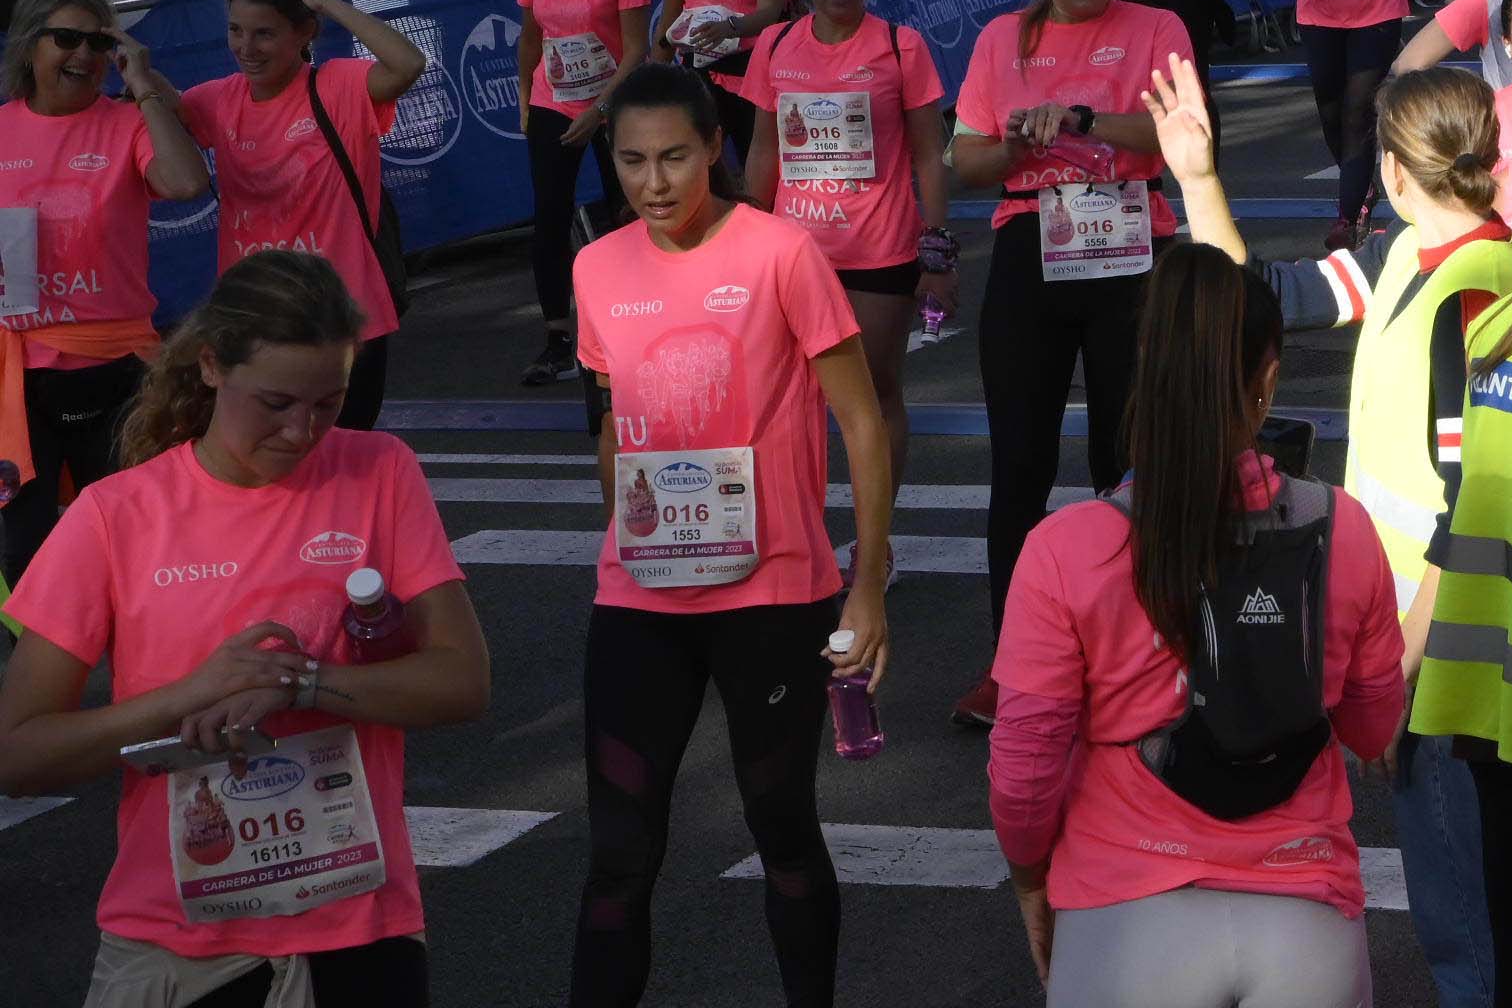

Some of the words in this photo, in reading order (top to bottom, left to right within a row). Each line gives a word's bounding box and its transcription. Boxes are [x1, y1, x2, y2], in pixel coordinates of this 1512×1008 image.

[565, 59, 589, 72] 016
[809, 126, 841, 139] 016
[790, 162, 818, 174] OYSHO
[1077, 219, 1114, 235] 016
[1084, 237, 1108, 248] 5556
[1055, 250, 1085, 260] CARRERA
[1085, 250, 1094, 258] DE
[1094, 249, 1103, 257] LA
[1103, 248, 1126, 257] MUJER
[1053, 264, 1086, 275] OYSHO
[1111, 260, 1145, 270] Santander
[610, 299, 663, 318] OYSHO
[615, 415, 648, 447] TU
[659, 473, 708, 487] ASTURIANA
[662, 503, 710, 524] 016
[671, 528, 701, 541] 1553
[633, 548, 671, 557] CARRERA
[671, 547, 683, 556] DE
[684, 547, 696, 555] LA
[696, 545, 723, 554] MUJER
[154, 560, 239, 587] OYSHO
[306, 540, 365, 561] ASTURIANA
[631, 566, 672, 578] OYSHO
[705, 562, 749, 574] Santander
[1236, 613, 1286, 625] AONIJIE
[228, 770, 300, 796] ASTURIANA
[238, 807, 306, 842] 016
[250, 840, 303, 865] 16113
[1150, 839, 1188, 856] AÑOS
[202, 875, 257, 893] CARRERA
[258, 871, 274, 881] DE
[277, 866, 292, 878] LA
[294, 857, 333, 875] MUJER
[336, 849, 363, 865] 2023
[202, 896, 263, 915] OYSHO
[310, 872, 370, 897] Santander
